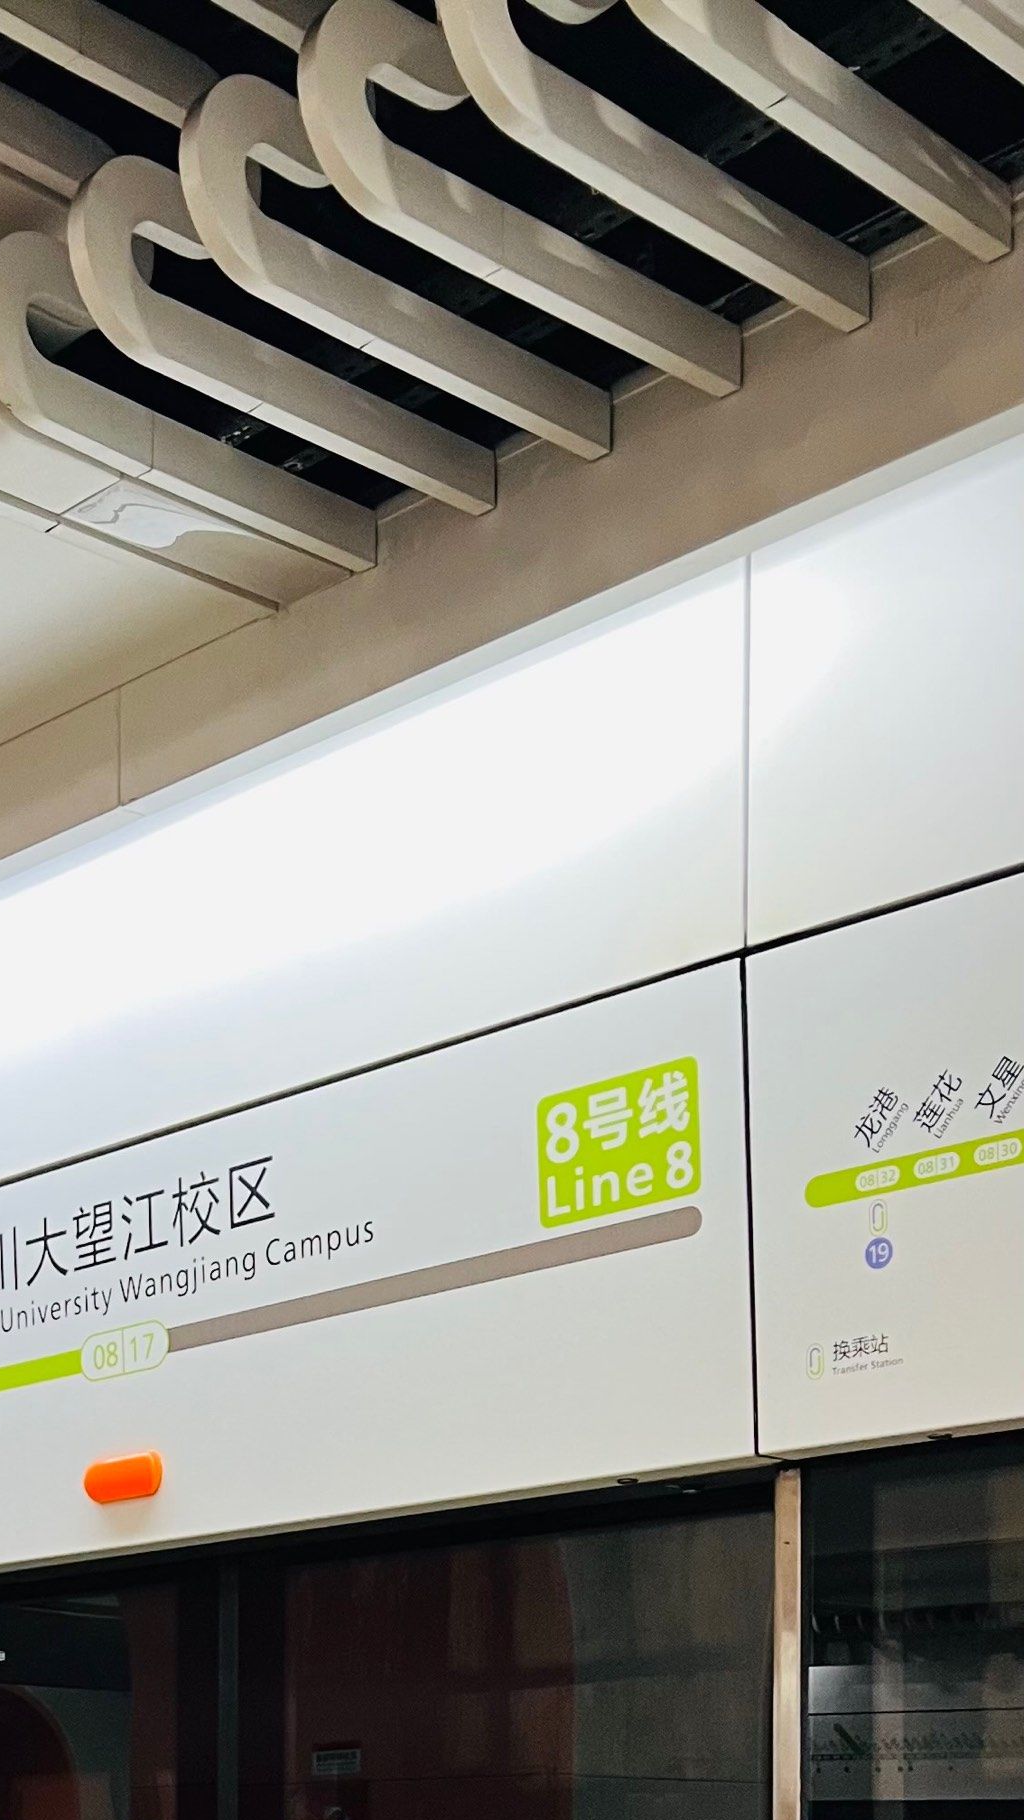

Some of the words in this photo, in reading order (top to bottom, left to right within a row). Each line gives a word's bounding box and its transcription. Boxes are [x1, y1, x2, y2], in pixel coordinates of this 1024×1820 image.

[913, 1069, 962, 1132] 莲花
[974, 1056, 1024, 1119] 文星
[994, 1078, 1024, 1124] Wenxin
[546, 1071, 690, 1164] 8号线
[854, 1087, 898, 1148] 龙港
[872, 1102, 909, 1153] Longgang
[933, 1098, 963, 1139] Lianhua
[547, 1162, 654, 1217] Line
[666, 1140, 694, 1189] 8
[0, 1285, 113, 1333] University
[119, 1249, 256, 1303] Wangjiang
[265, 1219, 375, 1266] Campus
[868, 1242, 889, 1264] 19
[832, 1334, 889, 1361] 换乘站
[832, 1363, 868, 1376] Transfer
[871, 1357, 904, 1369] Station
